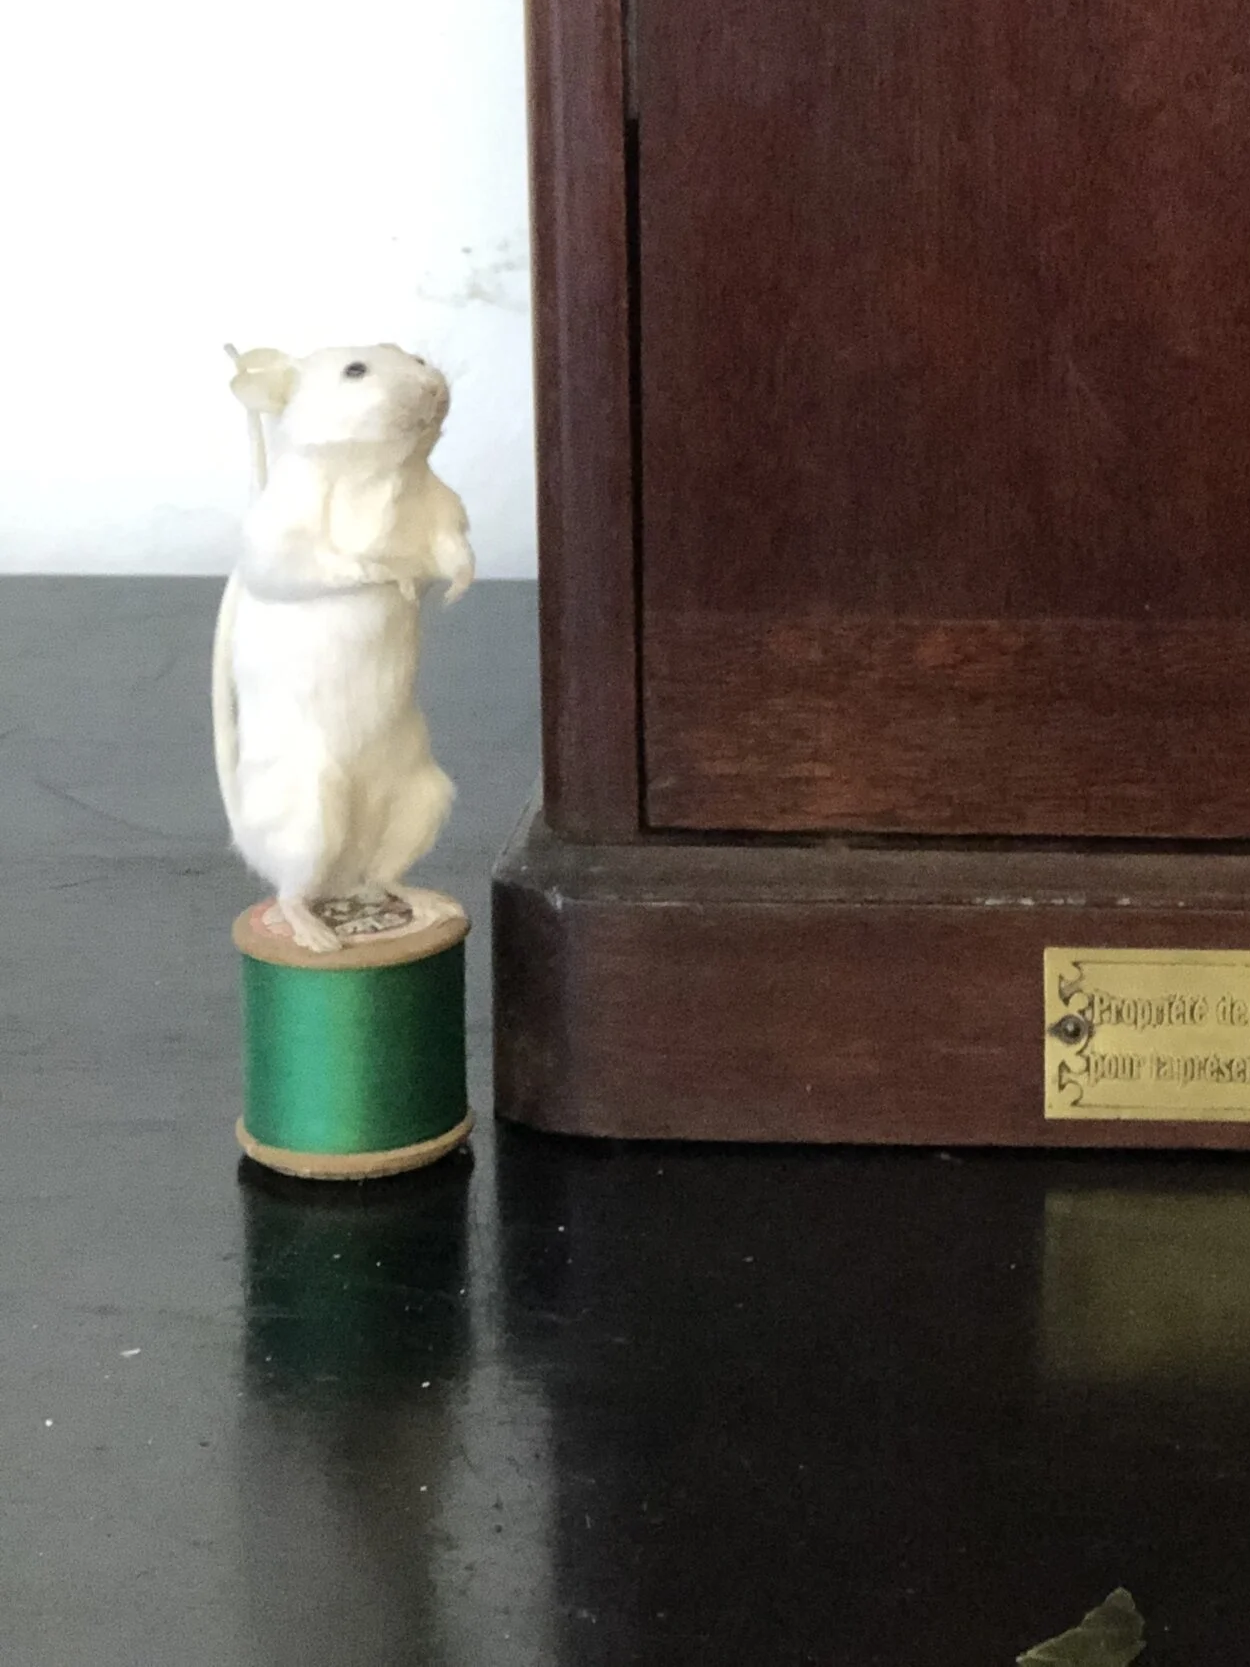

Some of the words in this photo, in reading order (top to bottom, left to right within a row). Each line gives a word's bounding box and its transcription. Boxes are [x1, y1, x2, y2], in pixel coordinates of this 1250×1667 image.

[1216, 993, 1249, 1026] de
[1086, 1052, 1143, 1086] pour
[1149, 1050, 1175, 1080] la
